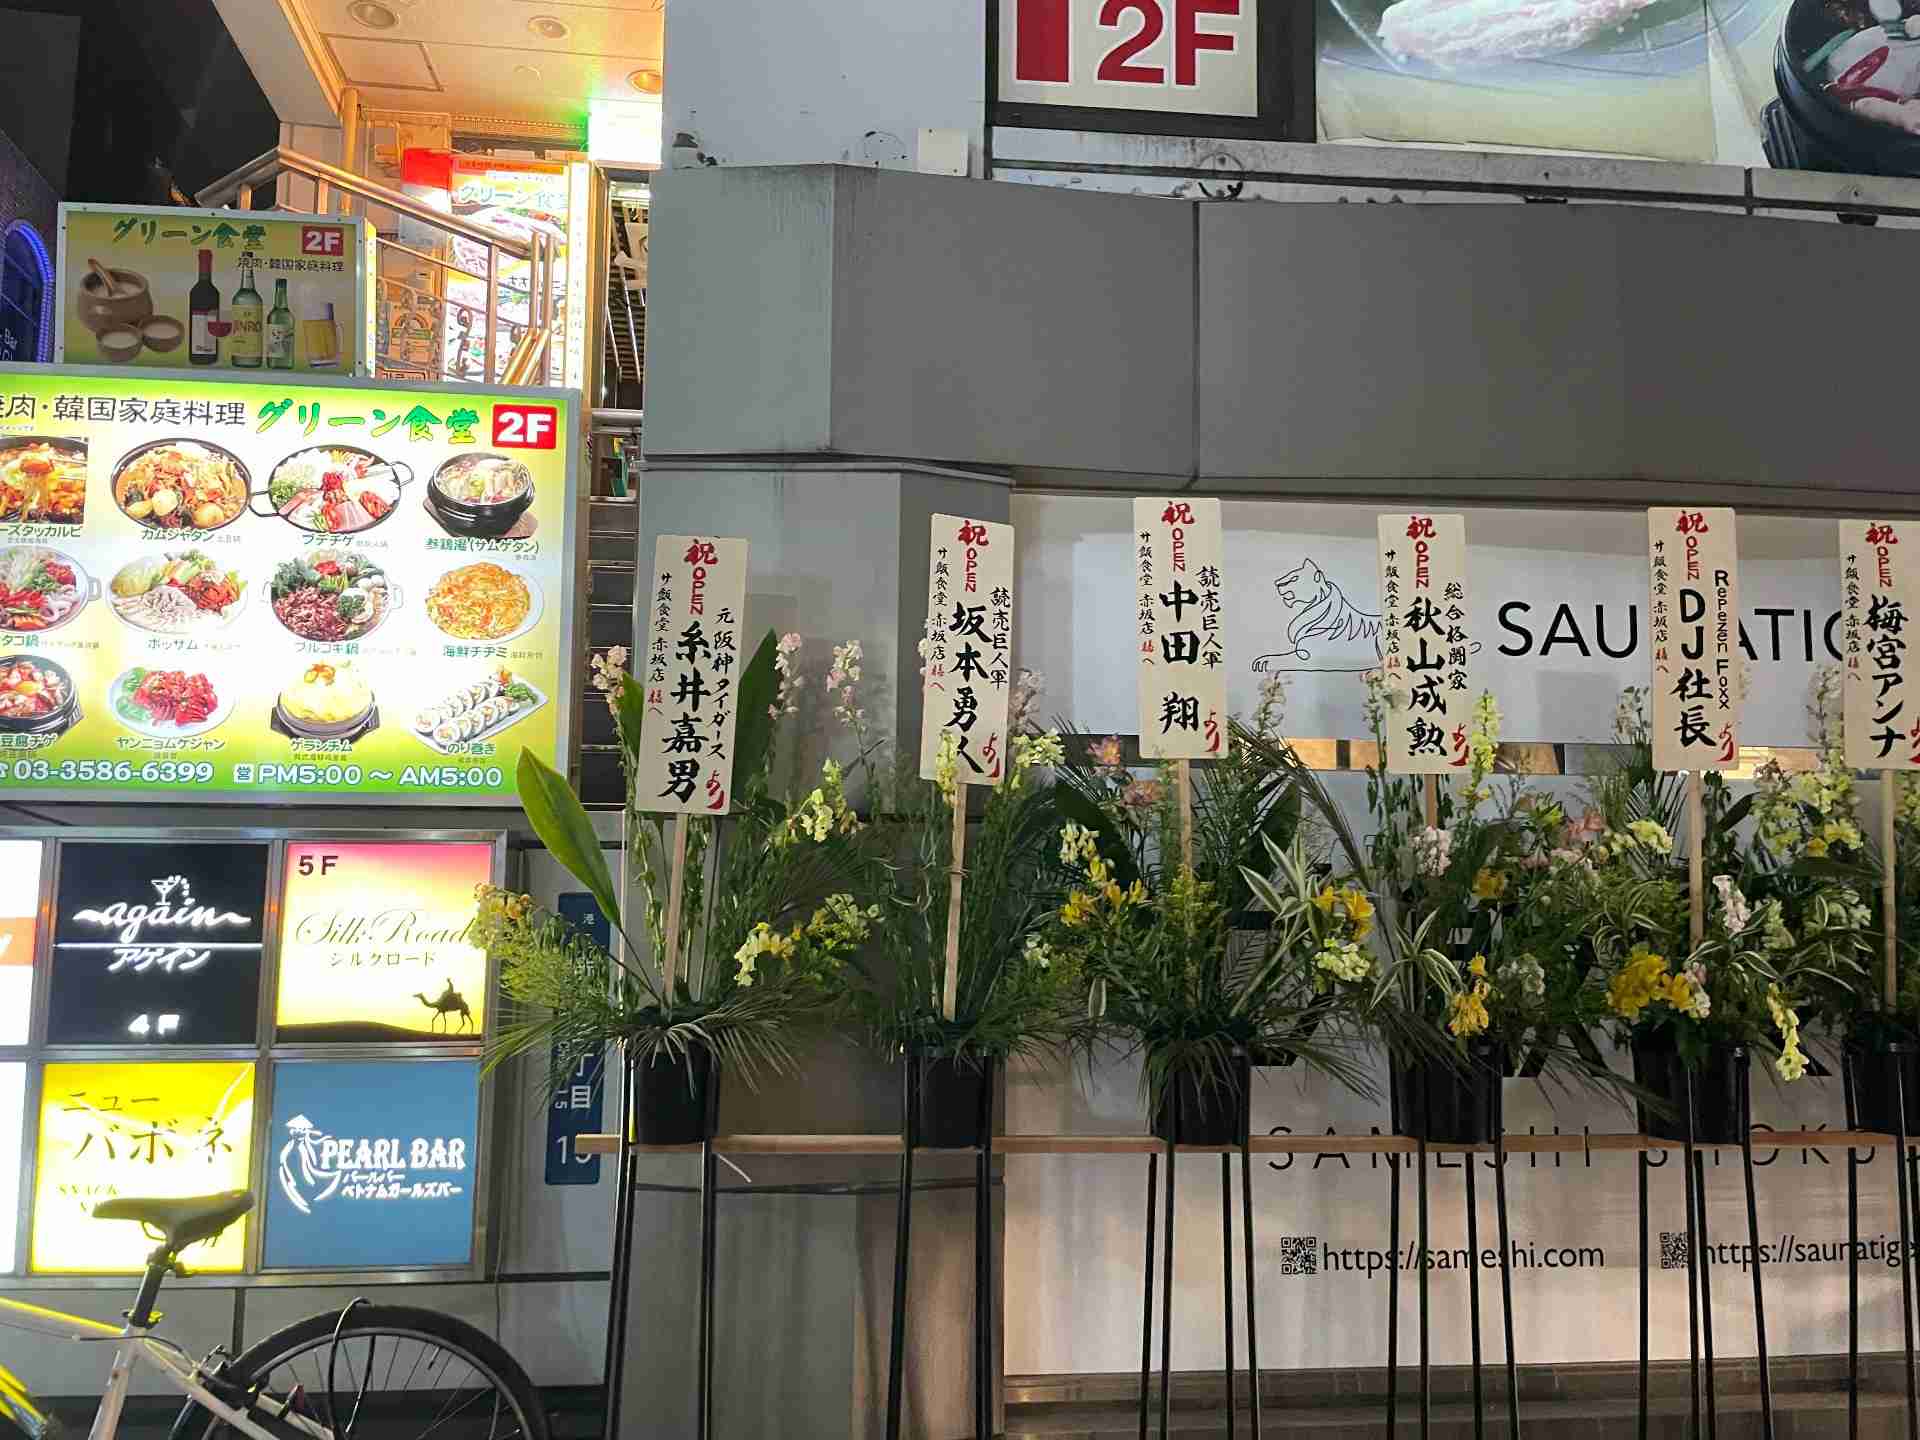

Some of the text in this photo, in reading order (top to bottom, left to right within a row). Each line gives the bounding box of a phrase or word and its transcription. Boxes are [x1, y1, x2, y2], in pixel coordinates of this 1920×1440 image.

[1097, 0, 1240, 86] 2F
[112, 217, 266, 250] グリーン食堂
[304, 231, 341, 252] 2F
[256, 397, 480, 444] グリーン食堂
[496, 409, 552, 443] 2F
[957, 519, 990, 593] 祝 OPEN
[1161, 501, 1195, 572] 祝 OPEN
[1405, 516, 1437, 589] 祝 OPEN
[1675, 511, 1709, 582] 祝 OPEN
[1865, 522, 1899, 588] 祝 OPEN
[684, 538, 719, 616] 祝 OPEN
[989, 586, 1012, 690] 読売巨人軍
[1196, 565, 1223, 669] 読売巨人軍
[943, 600, 994, 774] 坂本勇人
[1403, 596, 1448, 758] 秋山成勲
[1669, 588, 1718, 748] DJ社長
[1863, 594, 1909, 759] 梅宮アンナ
[657, 620, 713, 804] 糸井嘉男
[13, 759, 214, 783] 03-3586-6399
[257, 764, 362, 785] PM5:00
[398, 767, 503, 787] AM5:00
[299, 855, 340, 876] 5F
[82, 902, 242, 944] again
[296, 907, 477, 945] Silk Road
[107, 947, 212, 972] アゲイン
[328, 951, 437, 968] シルクロード
[127, 1013, 180, 1035] 4F
[63, 1091, 161, 1112] ニュー
[321, 1137, 466, 1170] PEARL BAR
[1323, 1240, 1604, 1279] https://samehi.com
